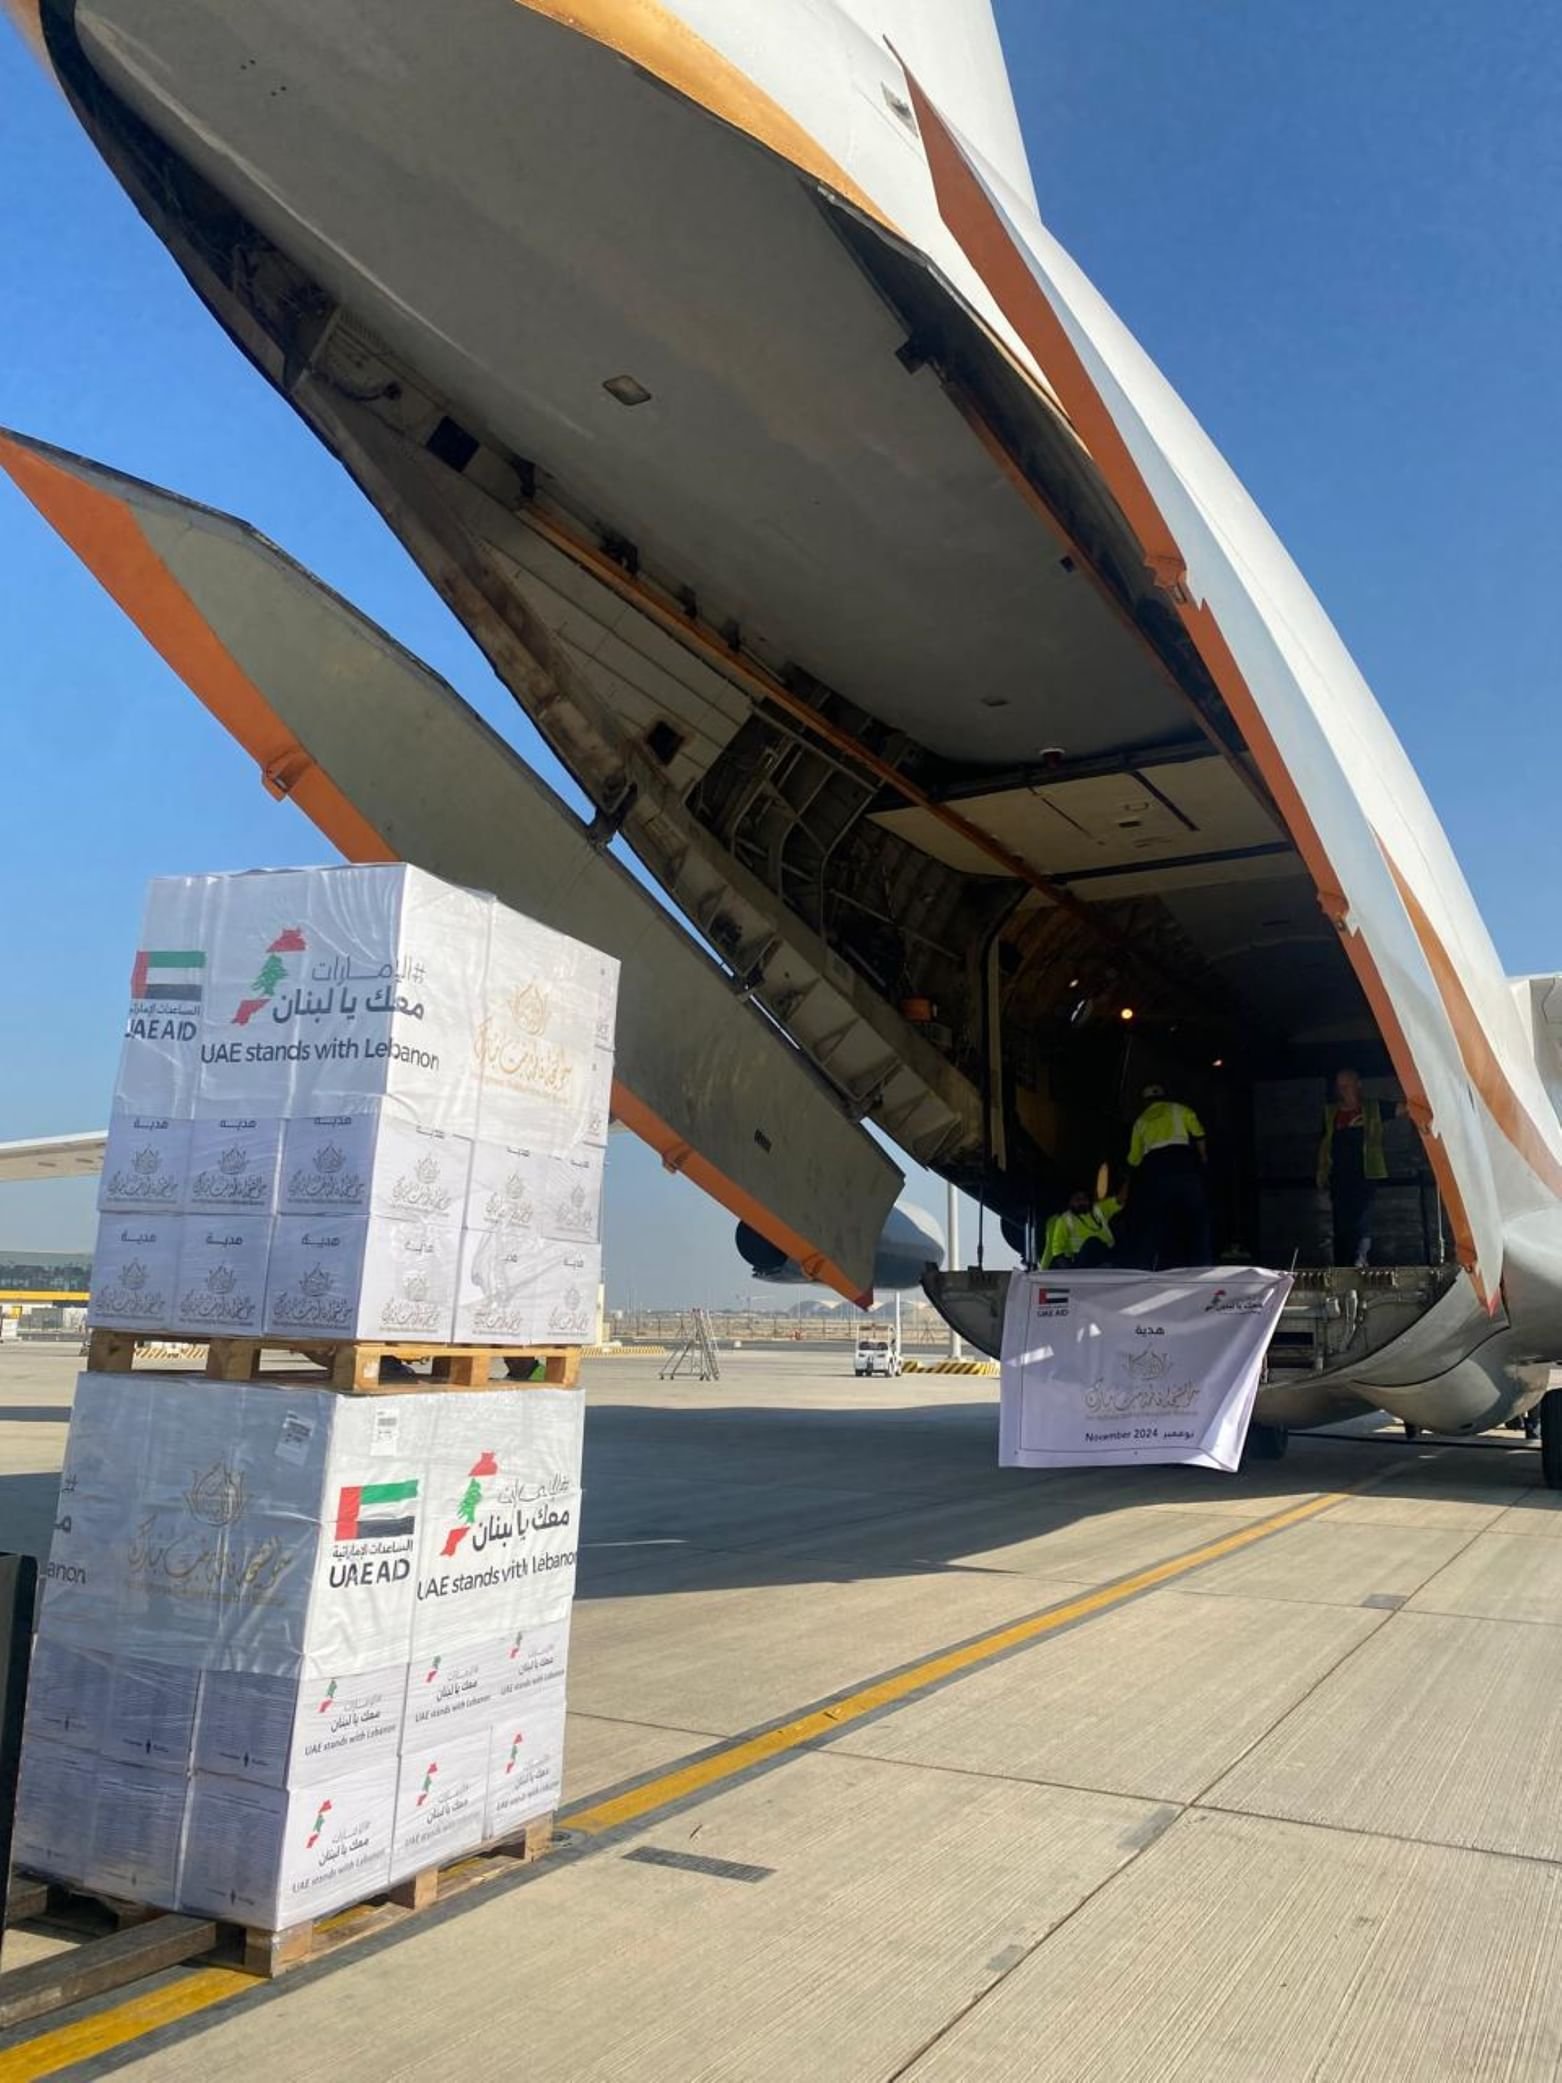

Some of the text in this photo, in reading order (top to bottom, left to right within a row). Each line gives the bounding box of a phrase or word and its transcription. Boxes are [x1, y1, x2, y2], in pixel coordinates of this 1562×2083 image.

[273, 985, 425, 1023] معك يا لبنان
[161, 1020, 197, 1041] AID
[201, 1037, 439, 1071] UAE stands with Lebanon
[1135, 1324, 1165, 1336] هدية
[1085, 1431, 1131, 1442] November
[1133, 1427, 1158, 1440] 2024
[472, 1503, 570, 1552] معك يا بنان
[47, 1562, 87, 1584] anon
[329, 1557, 410, 1588] UAE AD
[451, 1566, 500, 1593] stands
[532, 1551, 577, 1573] Lebano
